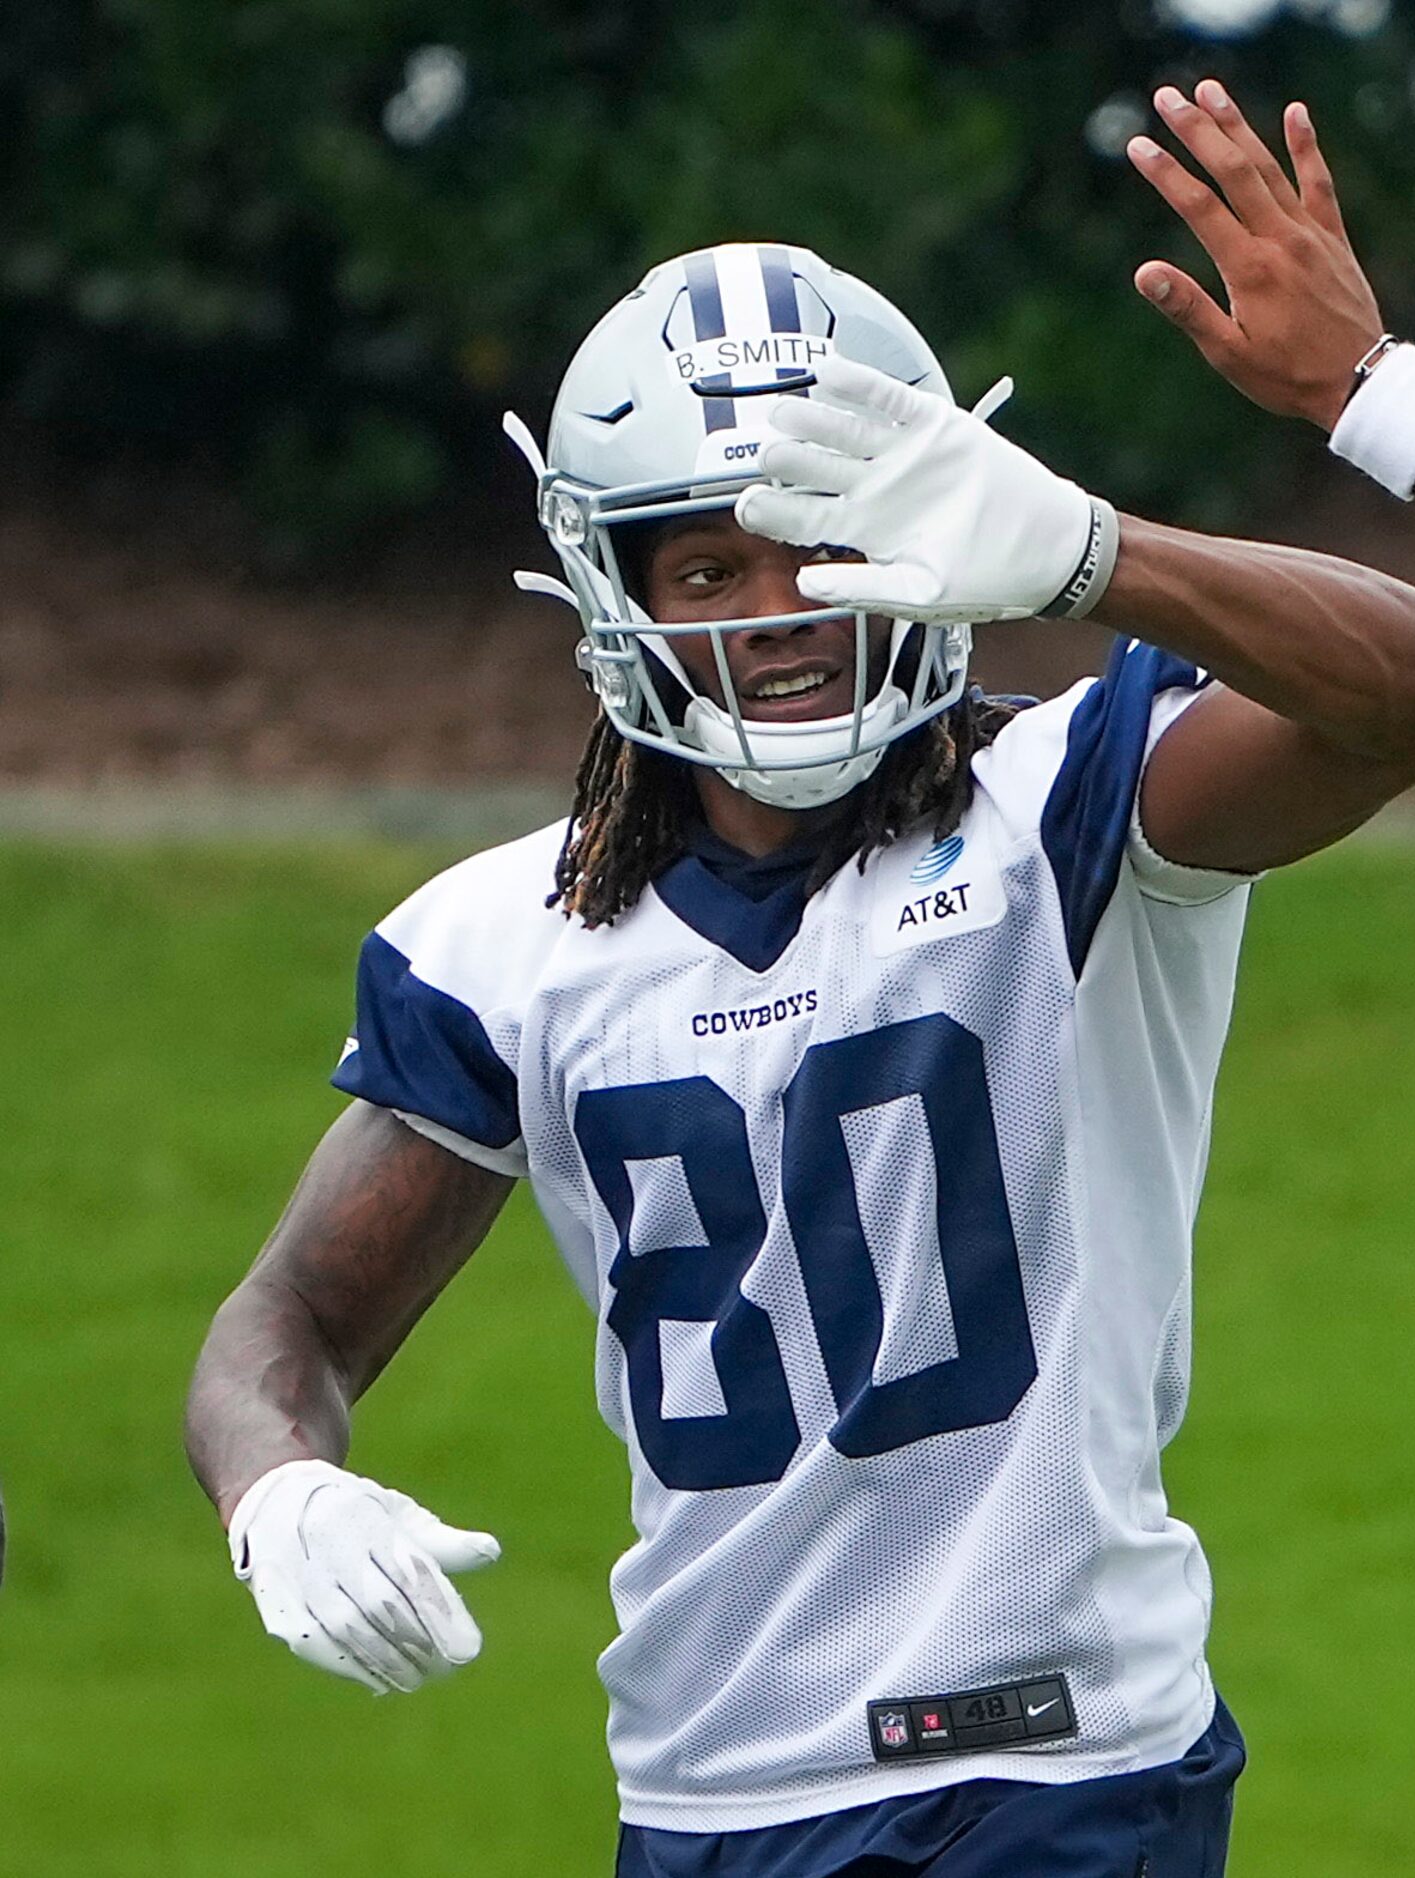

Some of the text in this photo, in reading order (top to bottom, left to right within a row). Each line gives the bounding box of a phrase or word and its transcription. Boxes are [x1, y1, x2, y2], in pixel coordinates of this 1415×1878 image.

[676, 338, 827, 379] B. SMITH
[724, 441, 761, 460] COW
[897, 882, 971, 932] AT&T
[692, 988, 818, 1037] COWBOYS
[574, 1012, 1038, 1490] 80
